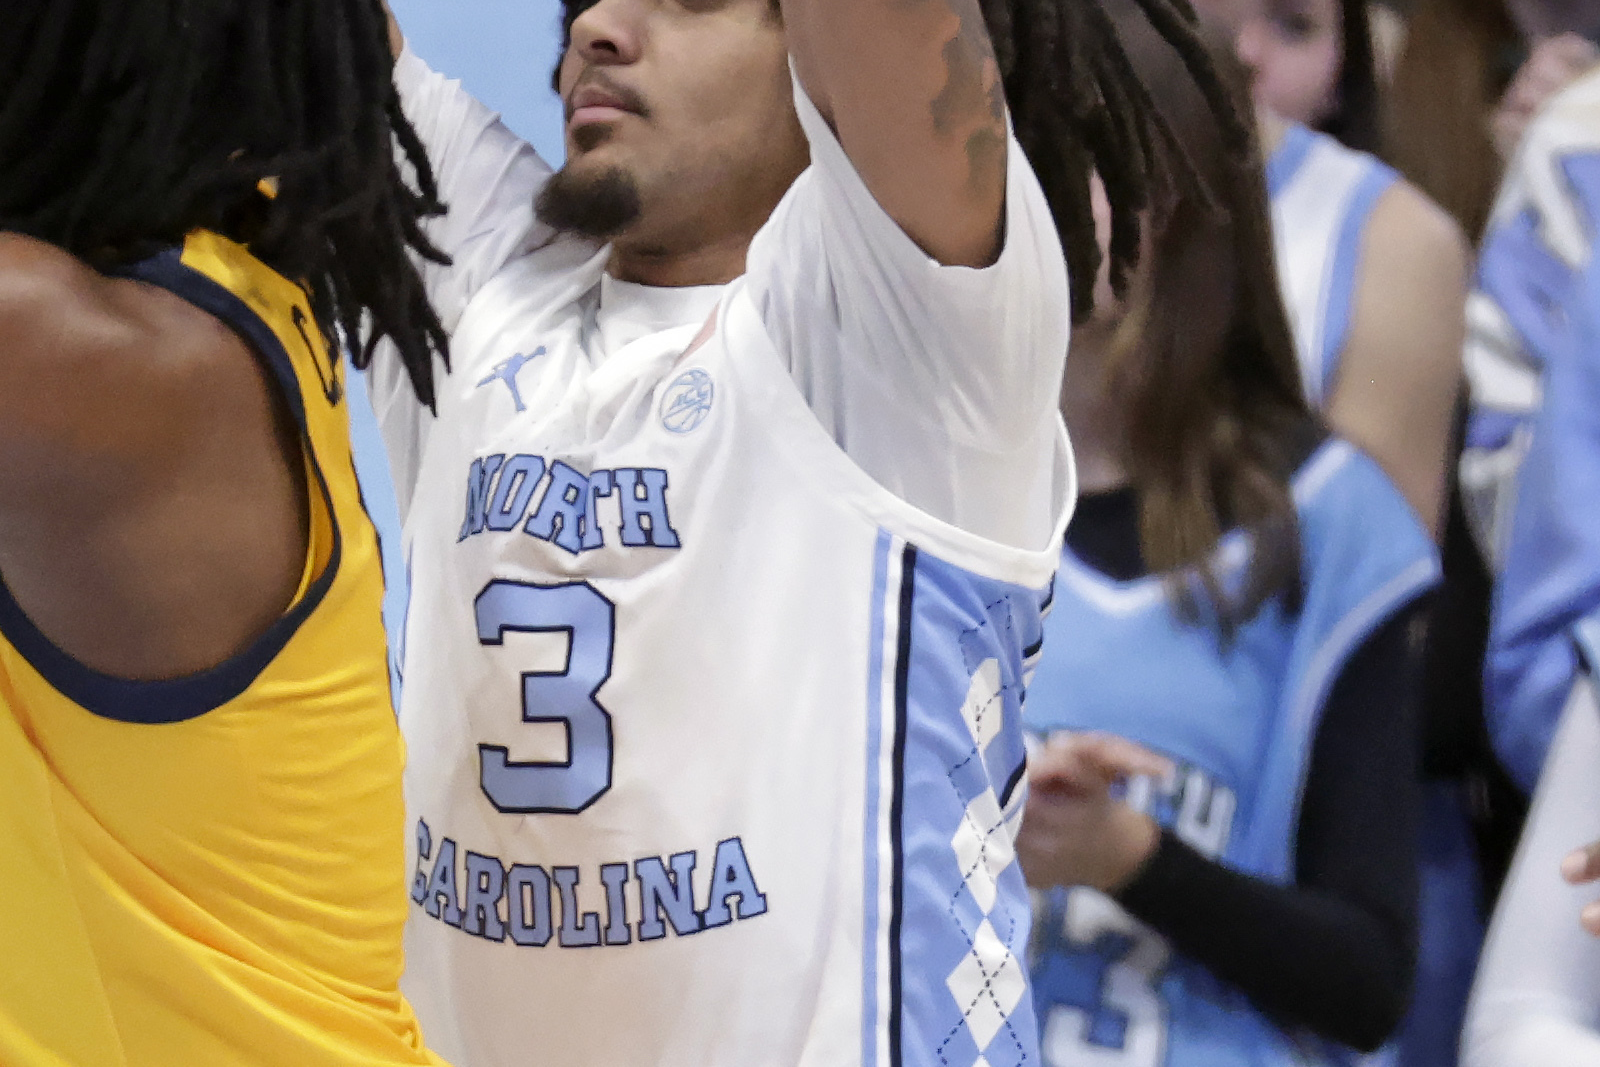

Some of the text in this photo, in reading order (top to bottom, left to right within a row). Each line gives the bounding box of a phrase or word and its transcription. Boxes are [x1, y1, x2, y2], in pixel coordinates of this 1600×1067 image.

[456, 453, 681, 555] NORTH
[474, 579, 615, 814] 3
[410, 817, 768, 948] CAROLINA
